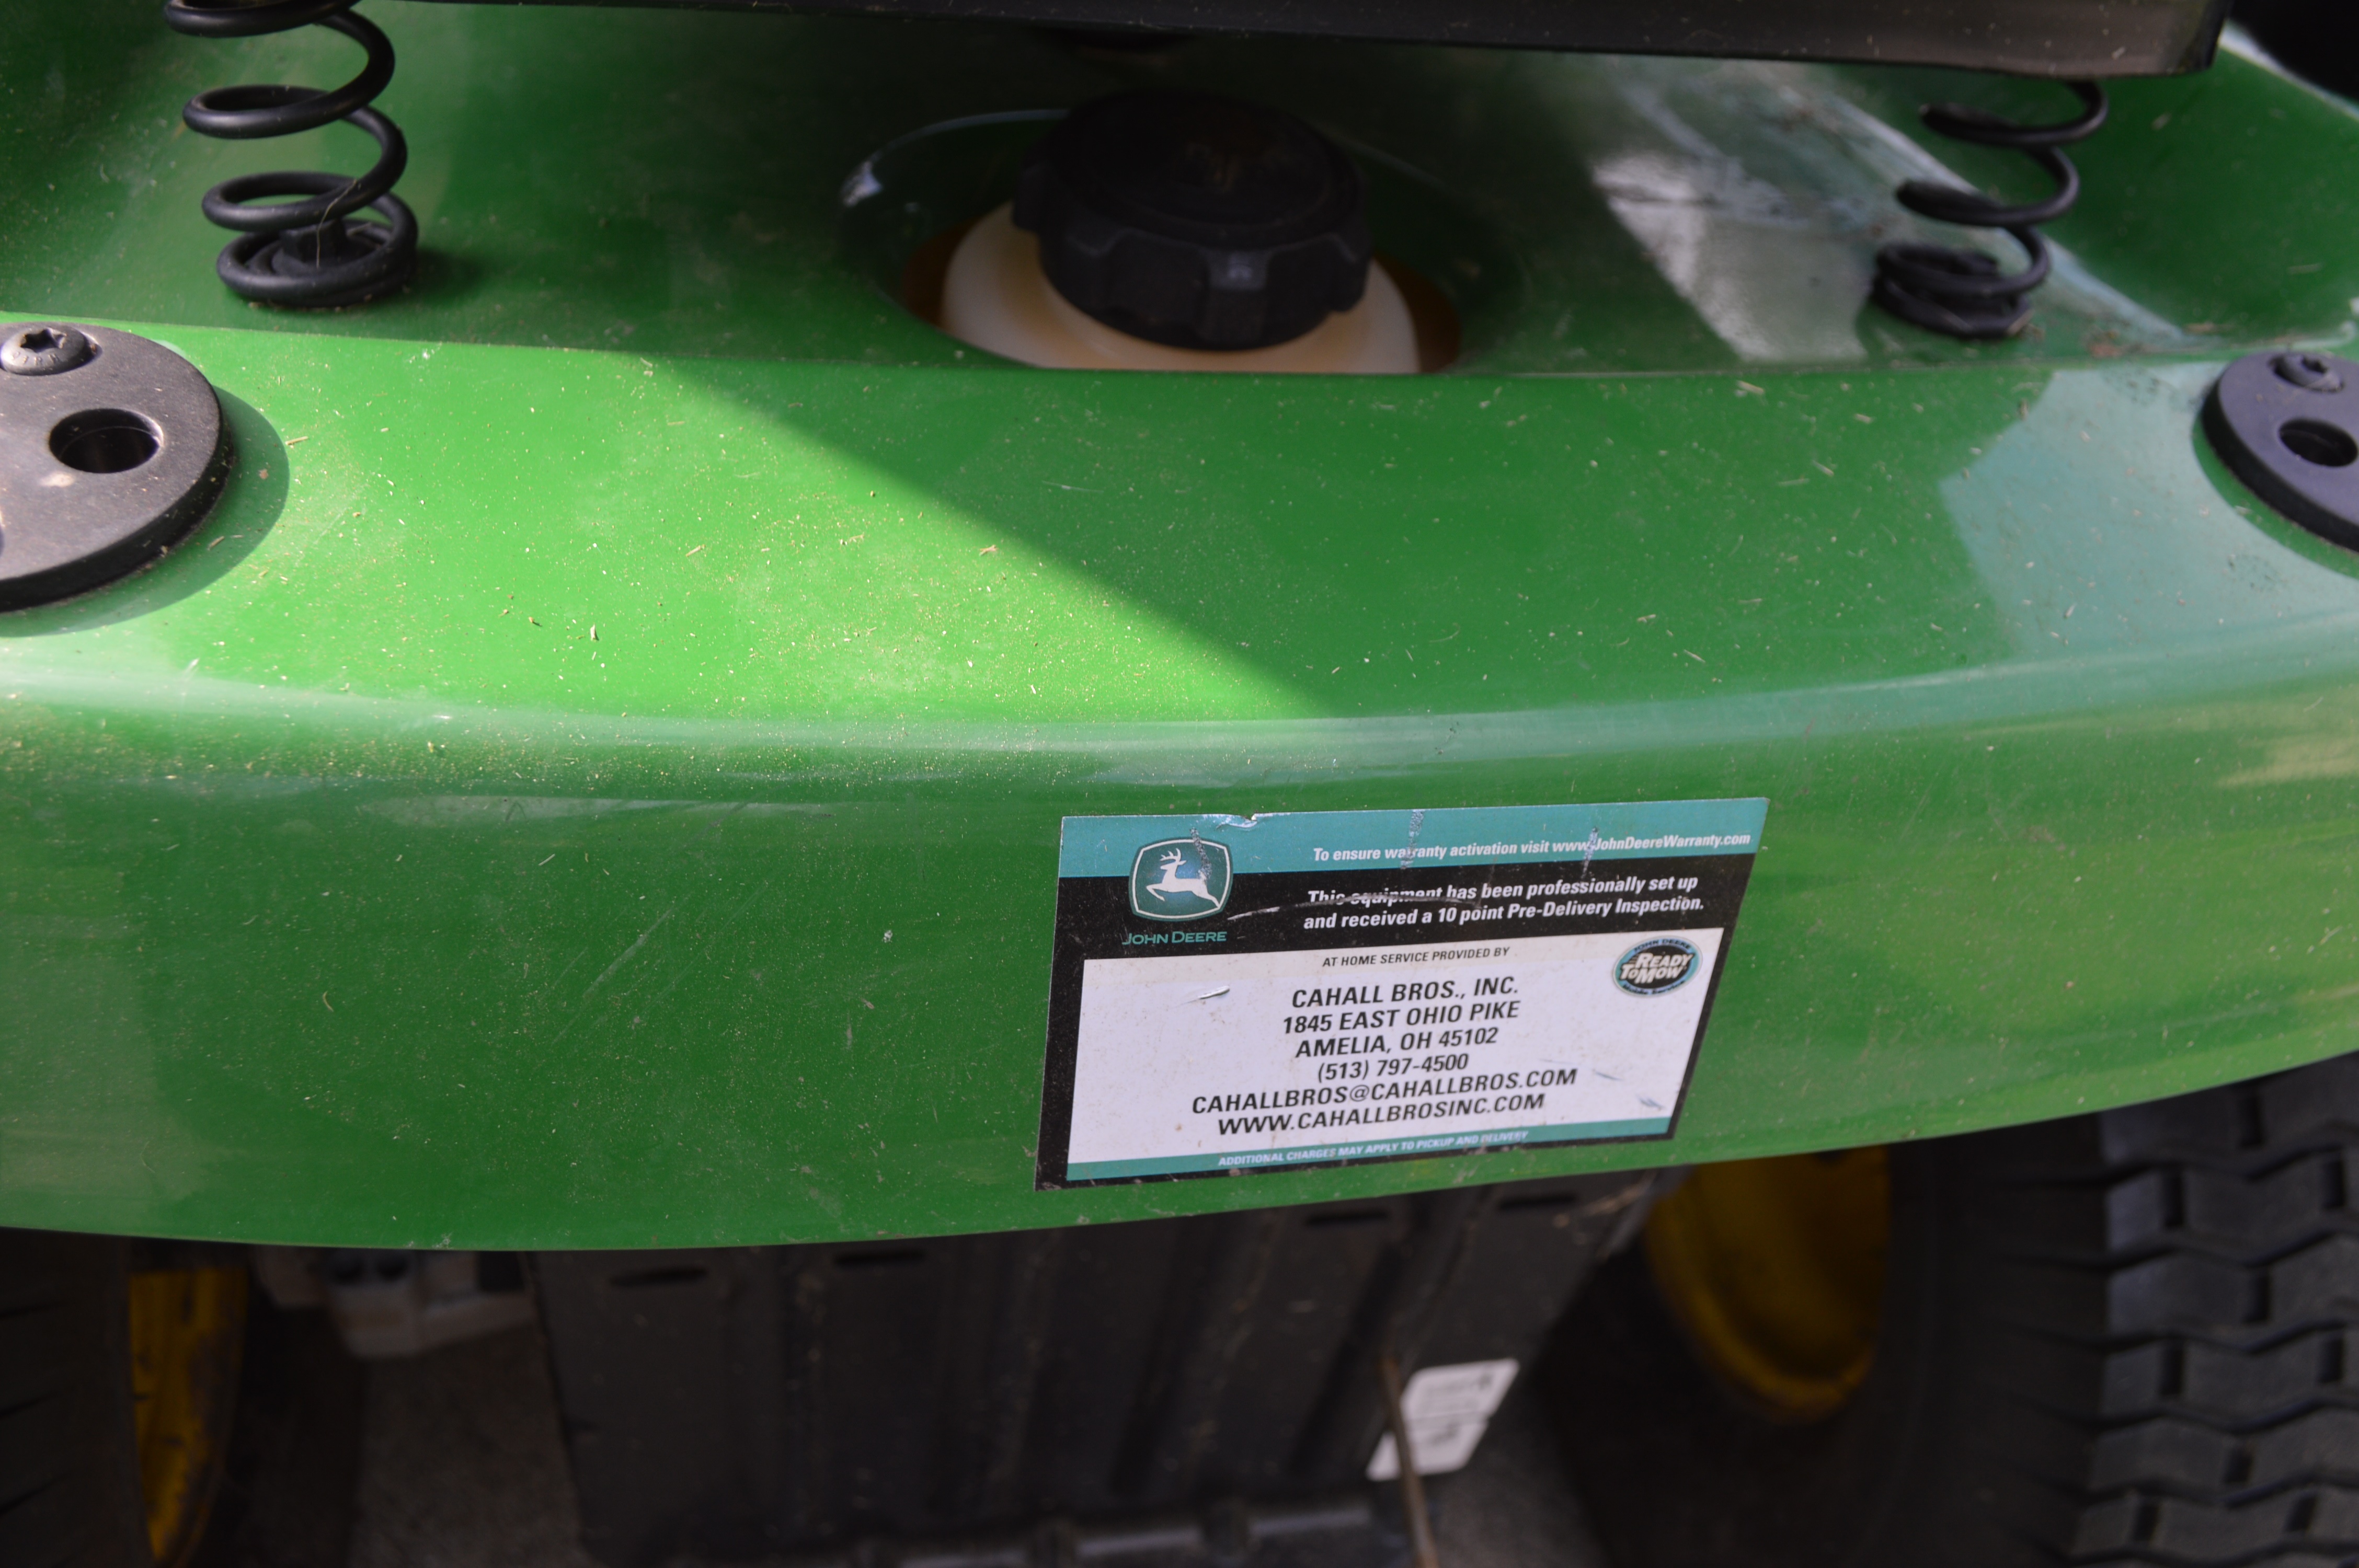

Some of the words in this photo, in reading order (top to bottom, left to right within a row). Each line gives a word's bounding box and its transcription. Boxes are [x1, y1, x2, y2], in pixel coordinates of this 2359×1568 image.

[1314, 848, 1329, 861] To
[1333, 847, 1381, 860] ensure
[1450, 843, 1517, 857] activation
[1521, 840, 1549, 854] visit
[1552, 834, 1750, 852] wwwJohnDeereWarranty.com
[1308, 890, 1345, 905] This
[1447, 884, 1477, 900] has
[1481, 883, 1522, 899] been
[1526, 876, 1646, 900] professionally
[1648, 877, 1675, 891] set
[1677, 877, 1698, 892] up
[1304, 913, 1337, 929] and
[1341, 909, 1418, 928] received
[1422, 912, 1433, 924] a
[1438, 907, 1457, 923] 10
[1459, 905, 1504, 925] point
[1507, 901, 1612, 918] Pre-Delivery
[1616, 896, 1704, 915] Inspection.
[1122, 932, 1169, 945] JOHN
[1172, 931, 1227, 943] DEERE
[1322, 957, 1338, 967] AT
[1341, 955, 1377, 966] HOME
[1380, 952, 1429, 964] SERVICE
[1432, 948, 1490, 962] PROVIDED
[1493, 947, 1510, 956] BY
[1292, 986, 1383, 1008] CAHALL
[1391, 981, 1465, 1002] BROS.,
[1473, 976, 1518, 996] INC.
[1283, 1013, 1332, 1034] 1845
[1339, 1009, 1400, 1030] EAST
[1406, 1005, 1462, 1026] OHIO
[1470, 1000, 1521, 1021] PIKE
[1295, 1034, 1391, 1058] AMELIA,
[1400, 1031, 1432, 1051] OH
[1438, 1027, 1499, 1047] 45102
[1318, 1060, 1369, 1083] (513)
[1377, 1053, 1469, 1076] 797-4500
[1193, 1068, 1578, 1114] CAHALLBROS@CAHALLBROS.COM
[1218, 1093, 1545, 1135] WWW.CAHALLBROSINC.COM
[1218, 1152, 1284, 1167] ADDITIONAL
[1286, 1148, 1336, 1161] CHARGES
[1337, 1146, 1364, 1157] MAY
[1365, 1143, 1399, 1154] APPLY
[1402, 1141, 1415, 1150] TO
[1416, 1137, 1455, 1149] PICKUP
[1456, 1135, 1479, 1145] AND
